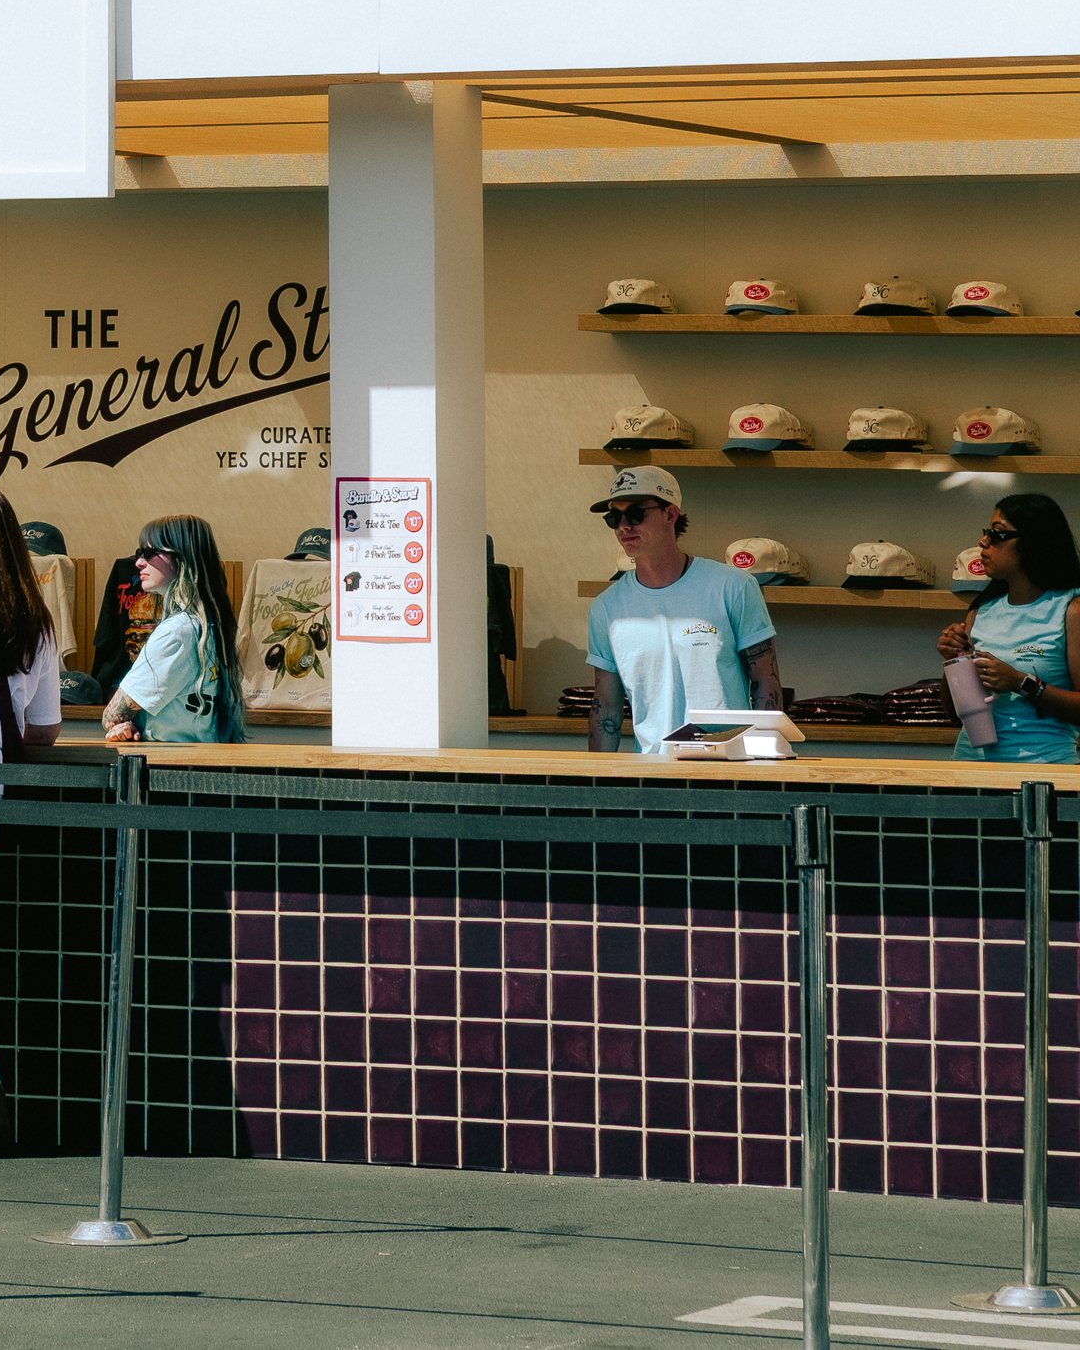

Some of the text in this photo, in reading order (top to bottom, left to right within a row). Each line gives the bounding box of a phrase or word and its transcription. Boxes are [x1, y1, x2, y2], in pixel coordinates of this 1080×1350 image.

[45, 309, 119, 348] THE
[216, 451, 331, 468] YES CHEF S
[346, 490, 381, 505] Bundle
[382, 489, 391, 502] &
